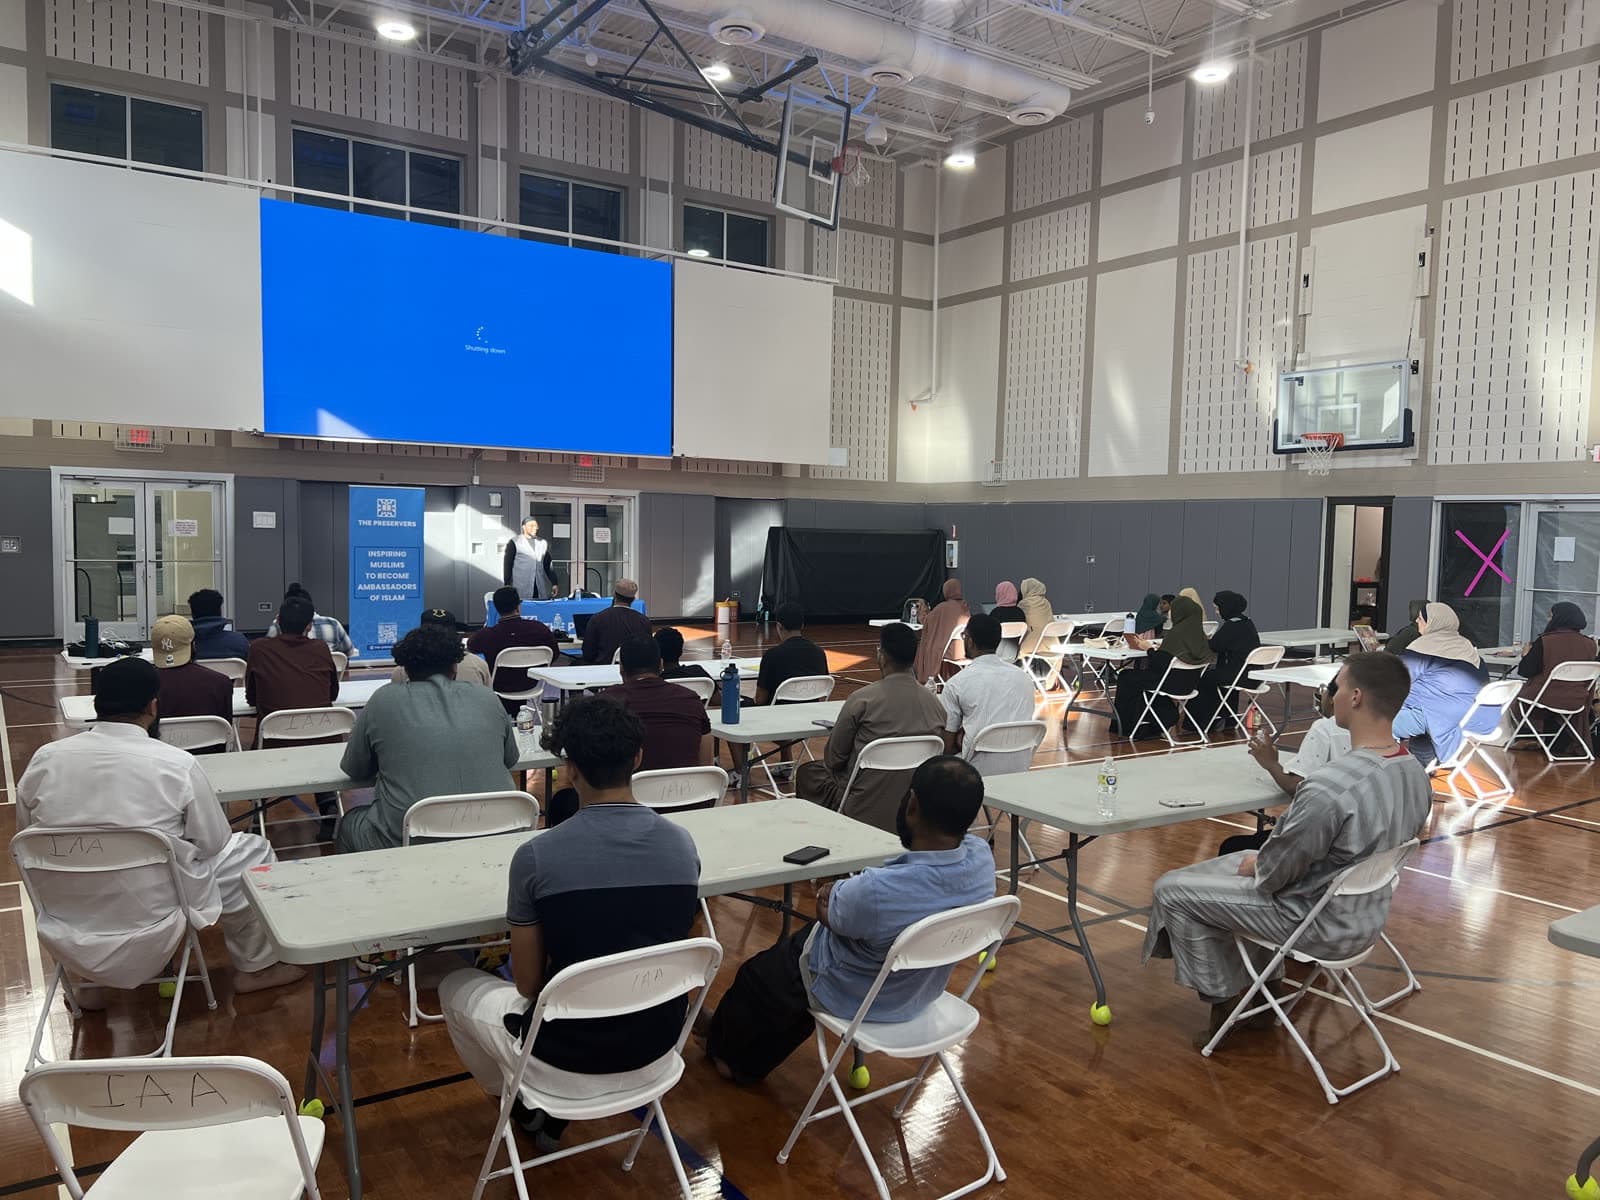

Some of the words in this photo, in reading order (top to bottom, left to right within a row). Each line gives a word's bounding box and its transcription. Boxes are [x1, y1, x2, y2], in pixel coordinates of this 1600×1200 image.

[464, 344, 489, 354] Shutting
[358, 519, 372, 527] THE
[373, 519, 417, 528] PRESERVERS
[368, 550, 407, 558] INSPIRING
[370, 561, 405, 569] MUSLIMS
[365, 572, 377, 580] TO
[377, 572, 410, 580] BECOME
[357, 583, 417, 591] AMBASSADORS
[369, 594, 380, 602] OF
[85, 1071, 228, 1109] IAA
